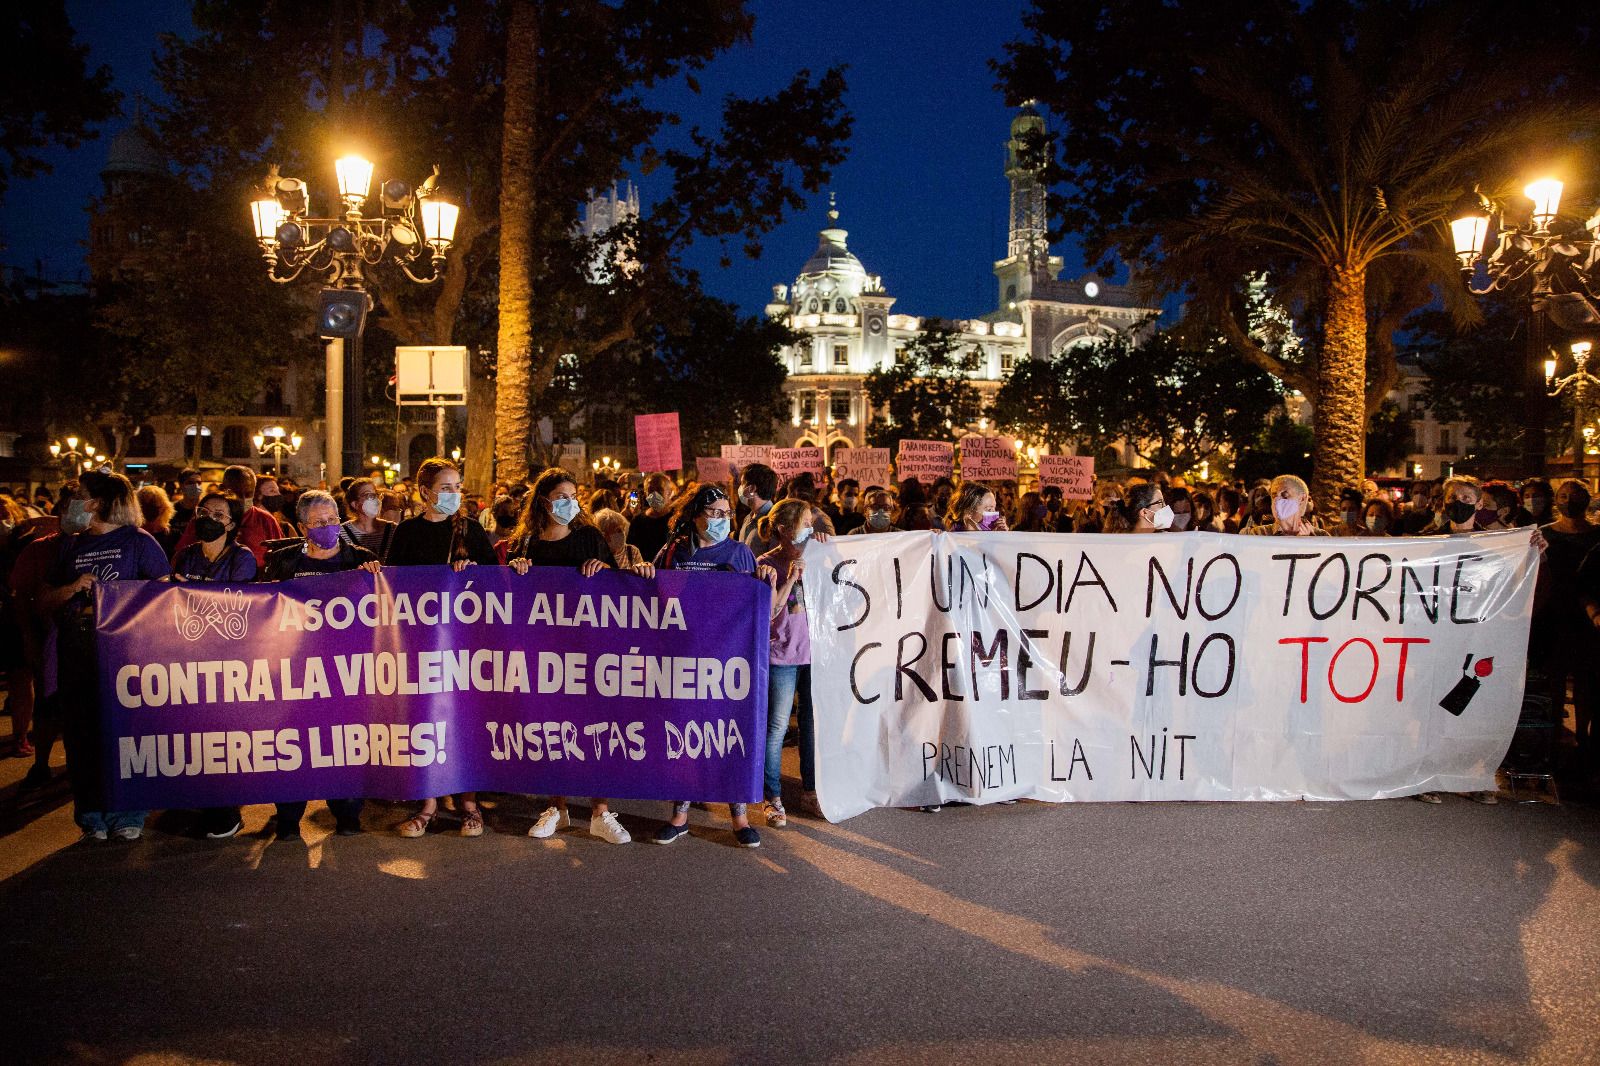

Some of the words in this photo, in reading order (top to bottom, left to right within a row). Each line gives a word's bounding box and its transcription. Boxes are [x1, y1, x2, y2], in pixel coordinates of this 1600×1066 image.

[900, 441, 919, 451] PARA
[984, 438, 1000, 449] ES
[782, 451, 789, 459] ES
[791, 450, 800, 459] UN
[801, 450, 819, 458] CASO
[836, 452, 847, 464] EL
[962, 449, 1014, 459] INDIVIDUAL
[1040, 456, 1082, 467] VIOLENCIA
[963, 467, 1016, 477] ESTRUCTURAL
[1050, 467, 1084, 477] VICARIA
[831, 557, 902, 632] SI
[930, 553, 990, 613] UN
[1014, 550, 1118, 614] DIA
[1146, 552, 1242, 622] NO
[1271, 552, 1484, 624] TORNE
[279, 580, 513, 632] ASOCIACIÓN
[528, 592, 688, 630] ALANNA
[1278, 636, 1431, 704] TOT
[116, 658, 275, 708] CONTRA
[280, 656, 331, 700] LA
[334, 648, 530, 697] VIOLENCIA
[538, 652, 588, 694] DE
[594, 646, 750, 700] GÉNERO
[486, 720, 646, 761] INSERTAS
[664, 718, 746, 760] DONA
[118, 728, 302, 779] MUJERES
[308, 720, 447, 768] LIBRES!
[922, 742, 1018, 790] PRENEM
[1050, 738, 1094, 782] LA
